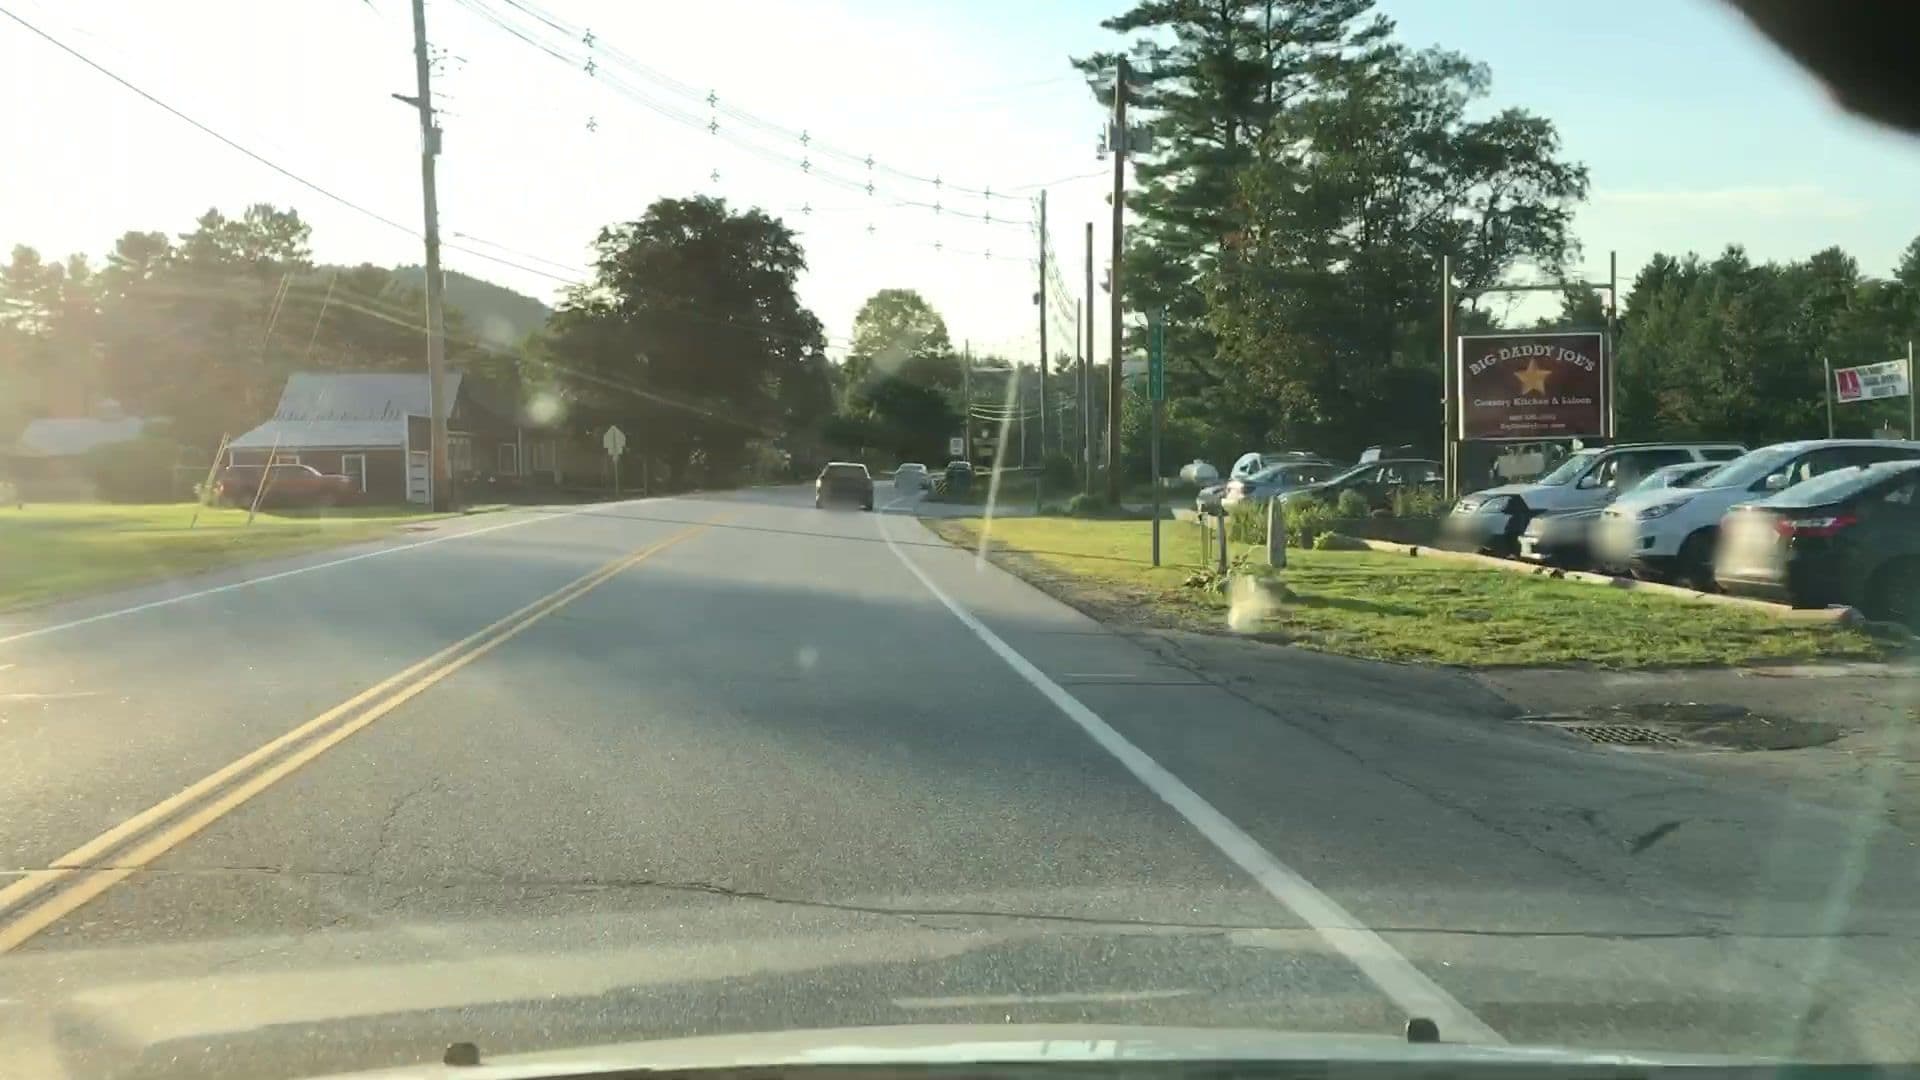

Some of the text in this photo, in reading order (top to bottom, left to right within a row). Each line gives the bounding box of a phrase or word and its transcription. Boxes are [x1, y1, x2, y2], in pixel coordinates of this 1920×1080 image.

[1469, 344, 1596, 376] BIG DADDY JOE'S
[1513, 397, 1549, 406] Kitchen
